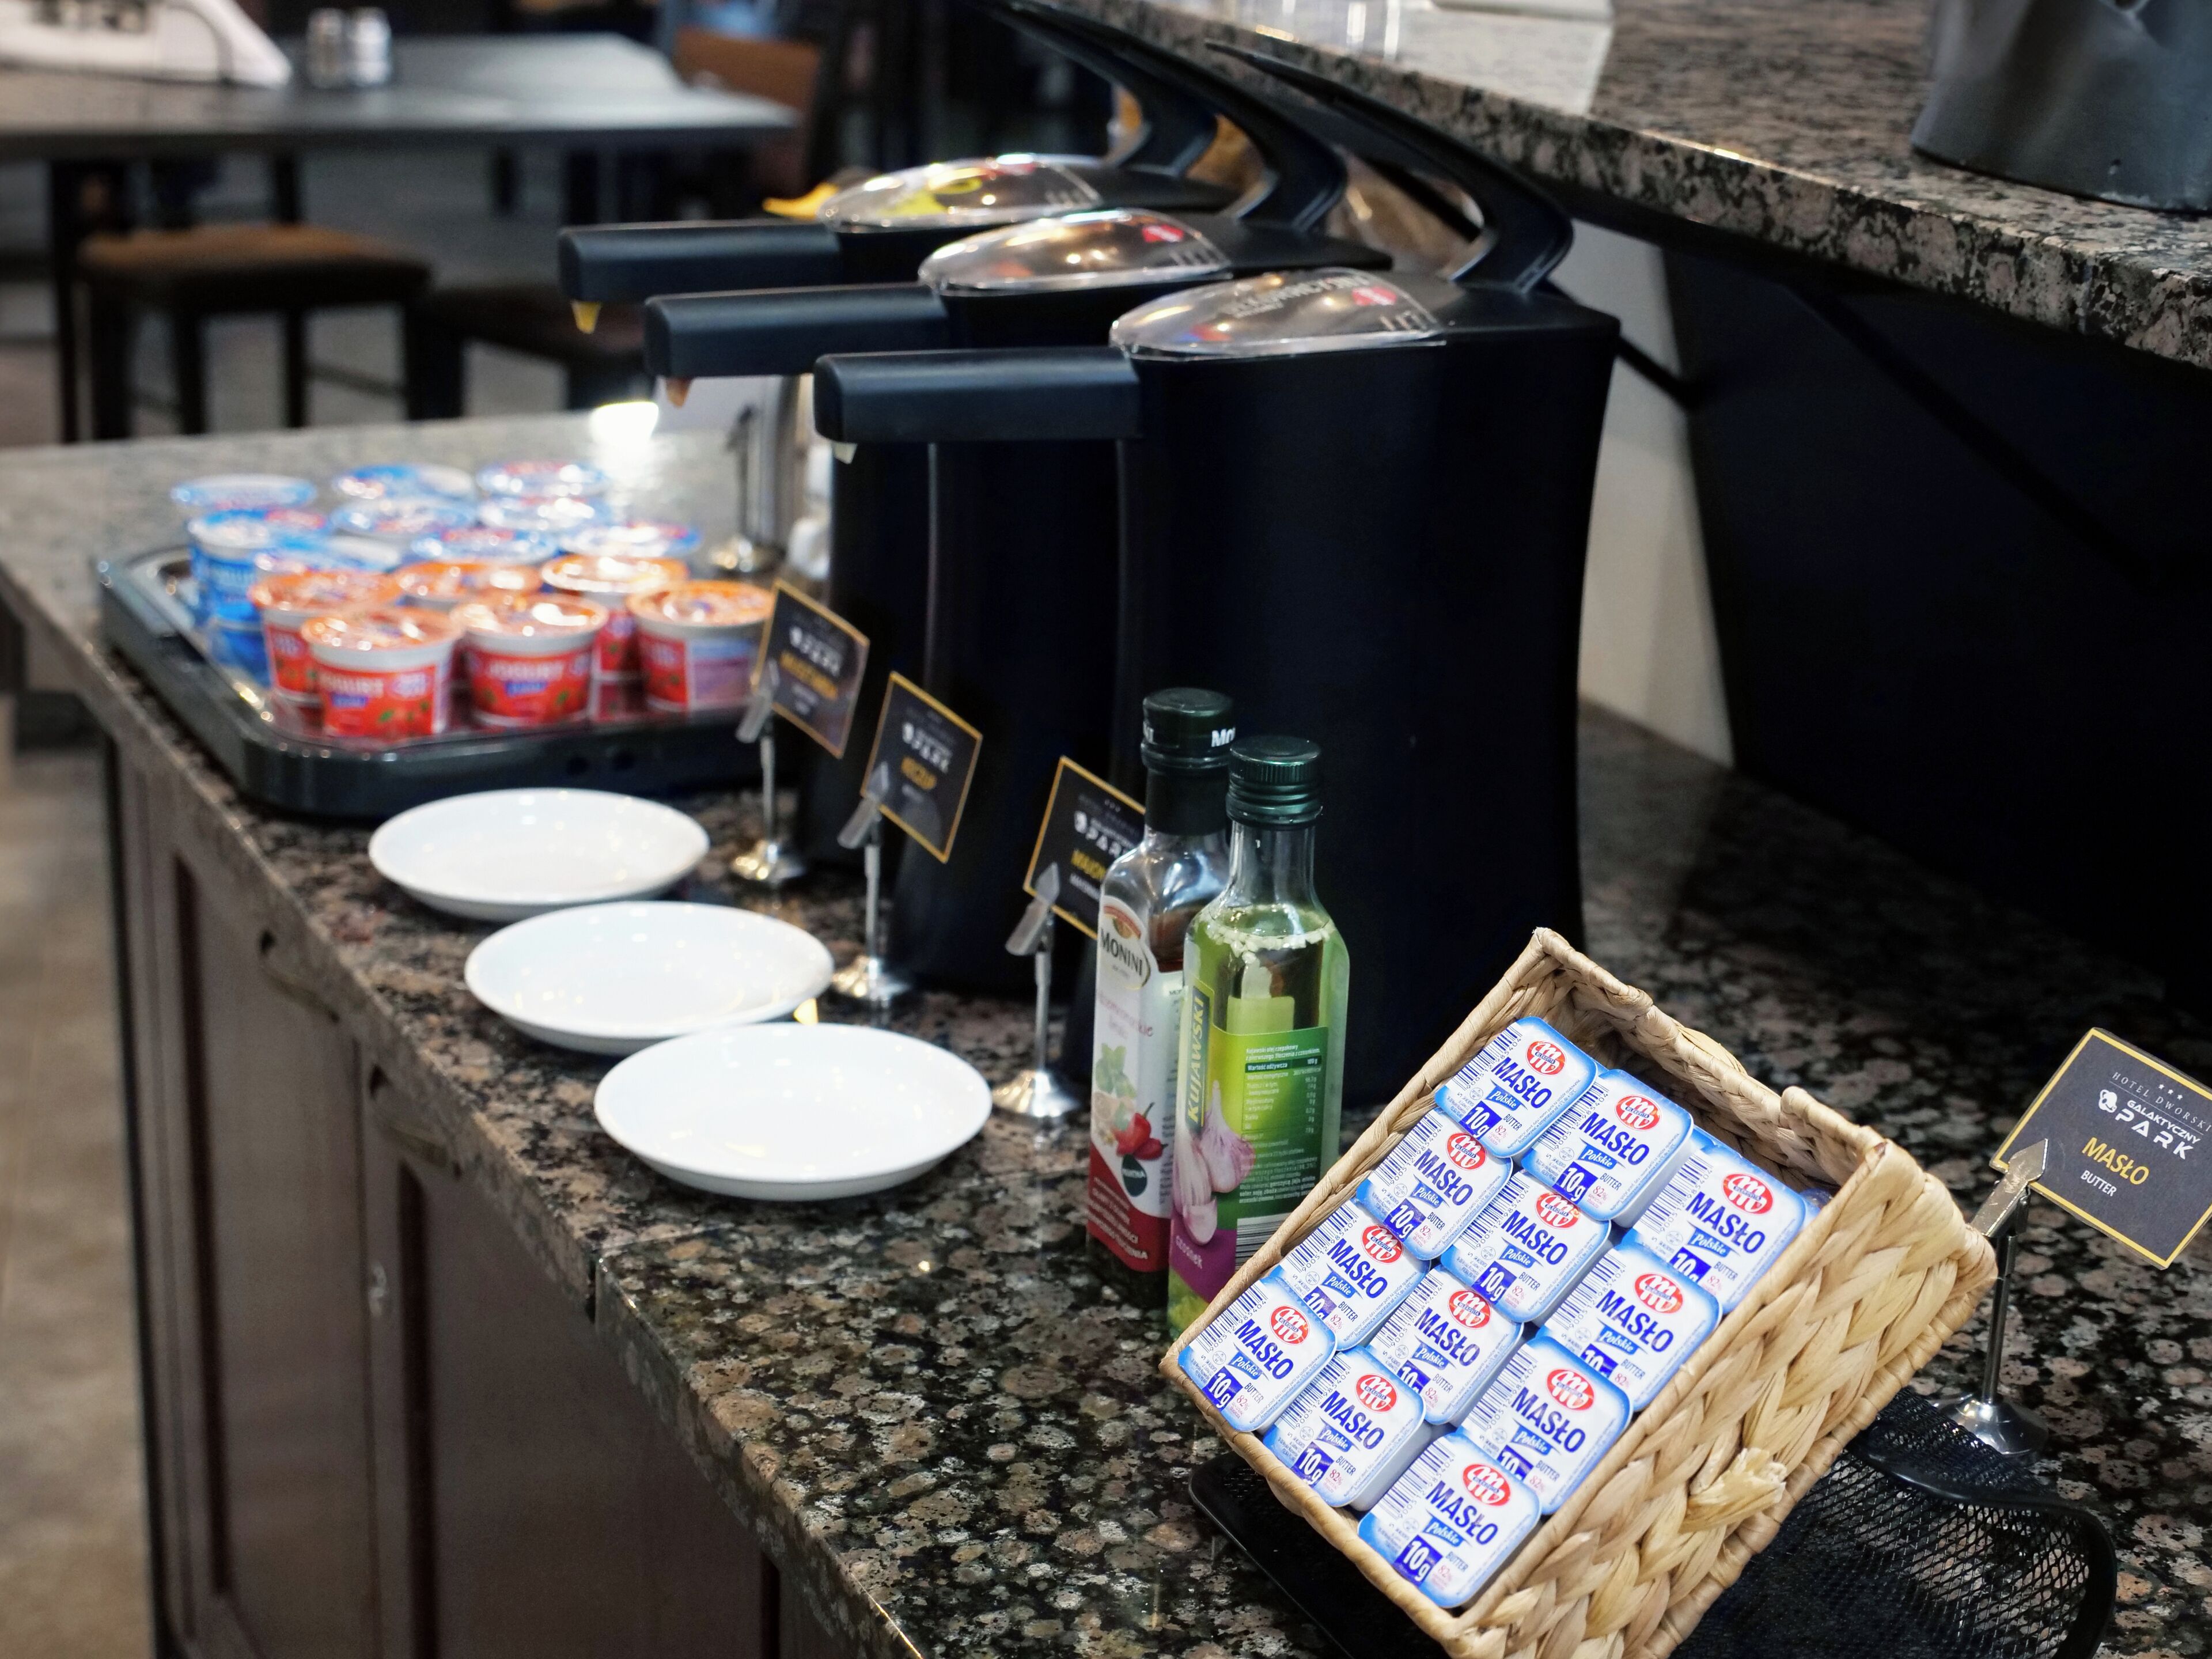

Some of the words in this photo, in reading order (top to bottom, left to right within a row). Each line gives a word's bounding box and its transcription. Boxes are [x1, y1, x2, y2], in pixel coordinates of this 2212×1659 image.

[1100, 928, 1143, 976] MONINI
[1188, 996, 1204, 1123] KUJAWSKI
[1466, 1064, 1491, 1089] 900512
[1495, 1039, 1522, 1062] 985404
[1490, 1090, 1518, 1108] Polskie
[1491, 1056, 1552, 1108] MASŁO
[2112, 1071, 2149, 1097] HOTEL
[2155, 1096, 2211, 1132] DWORSKI
[1465, 1107, 1490, 1138] 10g
[1502, 1113, 1522, 1131] BUTTER
[1554, 1122, 1580, 1150] 900512
[1582, 1093, 1608, 1120] 985404
[1579, 1112, 1649, 1165] MASŁO
[2115, 1108, 2194, 1160] PARK
[2127, 1100, 2201, 1144] GALAKTYCZNY
[1390, 1157, 1415, 1185] 900512
[1416, 1129, 1441, 1155] 985404
[1581, 1149, 1613, 1167] Polskie
[2081, 1137, 2150, 1185] MASŁO
[1414, 1148, 1474, 1206] MASŁO
[1560, 1168, 1586, 1202] 10g
[1600, 1172, 1622, 1191] BUTTER
[2080, 1169, 2117, 1196] BUTTER
[1414, 1187, 1440, 1206] Polskie
[1389, 1205, 1415, 1239] 10g
[1427, 1211, 1446, 1231] BUTTER
[1476, 1220, 1502, 1248] 900512
[1503, 1190, 1529, 1217] 985404
[1685, 1191, 1766, 1253] MASŁO
[1302, 1246, 1328, 1272] 900512
[1331, 1220, 1357, 1244] 985404
[1501, 1210, 1568, 1265] MASŁO
[1691, 1234, 1726, 1255] Polskie
[1327, 1238, 1388, 1298] MASŁO
[1501, 1248, 1531, 1266] Polskie
[1714, 1261, 1738, 1281] BUTTER
[1324, 1276, 1351, 1296] Polskie
[1480, 1267, 1506, 1302] 10g
[1518, 1272, 1540, 1291] BUTTER
[1210, 1326, 1235, 1351] 900512
[1238, 1301, 1266, 1324] 985404
[1338, 1301, 1358, 1322] BUTTER
[1596, 1289, 1674, 1353] MASŁO
[1234, 1319, 1293, 1380] MASŁO
[1414, 1307, 1480, 1366] MASŁO
[1599, 1331, 1634, 1352] Polskie
[1231, 1356, 1258, 1377] Polskie
[1415, 1348, 1444, 1367] Polskie
[1582, 1351, 1608, 1377] 10
[1620, 1359, 1646, 1380] BUTTER
[1209, 1372, 1232, 1408] 10g
[1244, 1382, 1264, 1404] BUTTER
[1399, 1367, 1421, 1393] 10
[1433, 1373, 1453, 1393] BUTTER
[1296, 1400, 1320, 1428] 900512
[1323, 1370, 1350, 1397] 985404
[1320, 1390, 1385, 1449] MASŁO
[1511, 1387, 1585, 1453] MASŁO
[1320, 1430, 1349, 1449] Polskie
[1514, 1431, 1547, 1452] Polskie
[1298, 1448, 1323, 1484] 10g
[1336, 1456, 1357, 1476] BUTTER
[1500, 1453, 1522, 1480] 10
[1536, 1460, 1560, 1482] BUTTER
[1425, 1480, 1498, 1545] MASŁO
[1426, 1522, 1459, 1544] Polskie
[1403, 1541, 1431, 1582] 10g
[1446, 1551, 1469, 1573] BUTTER
